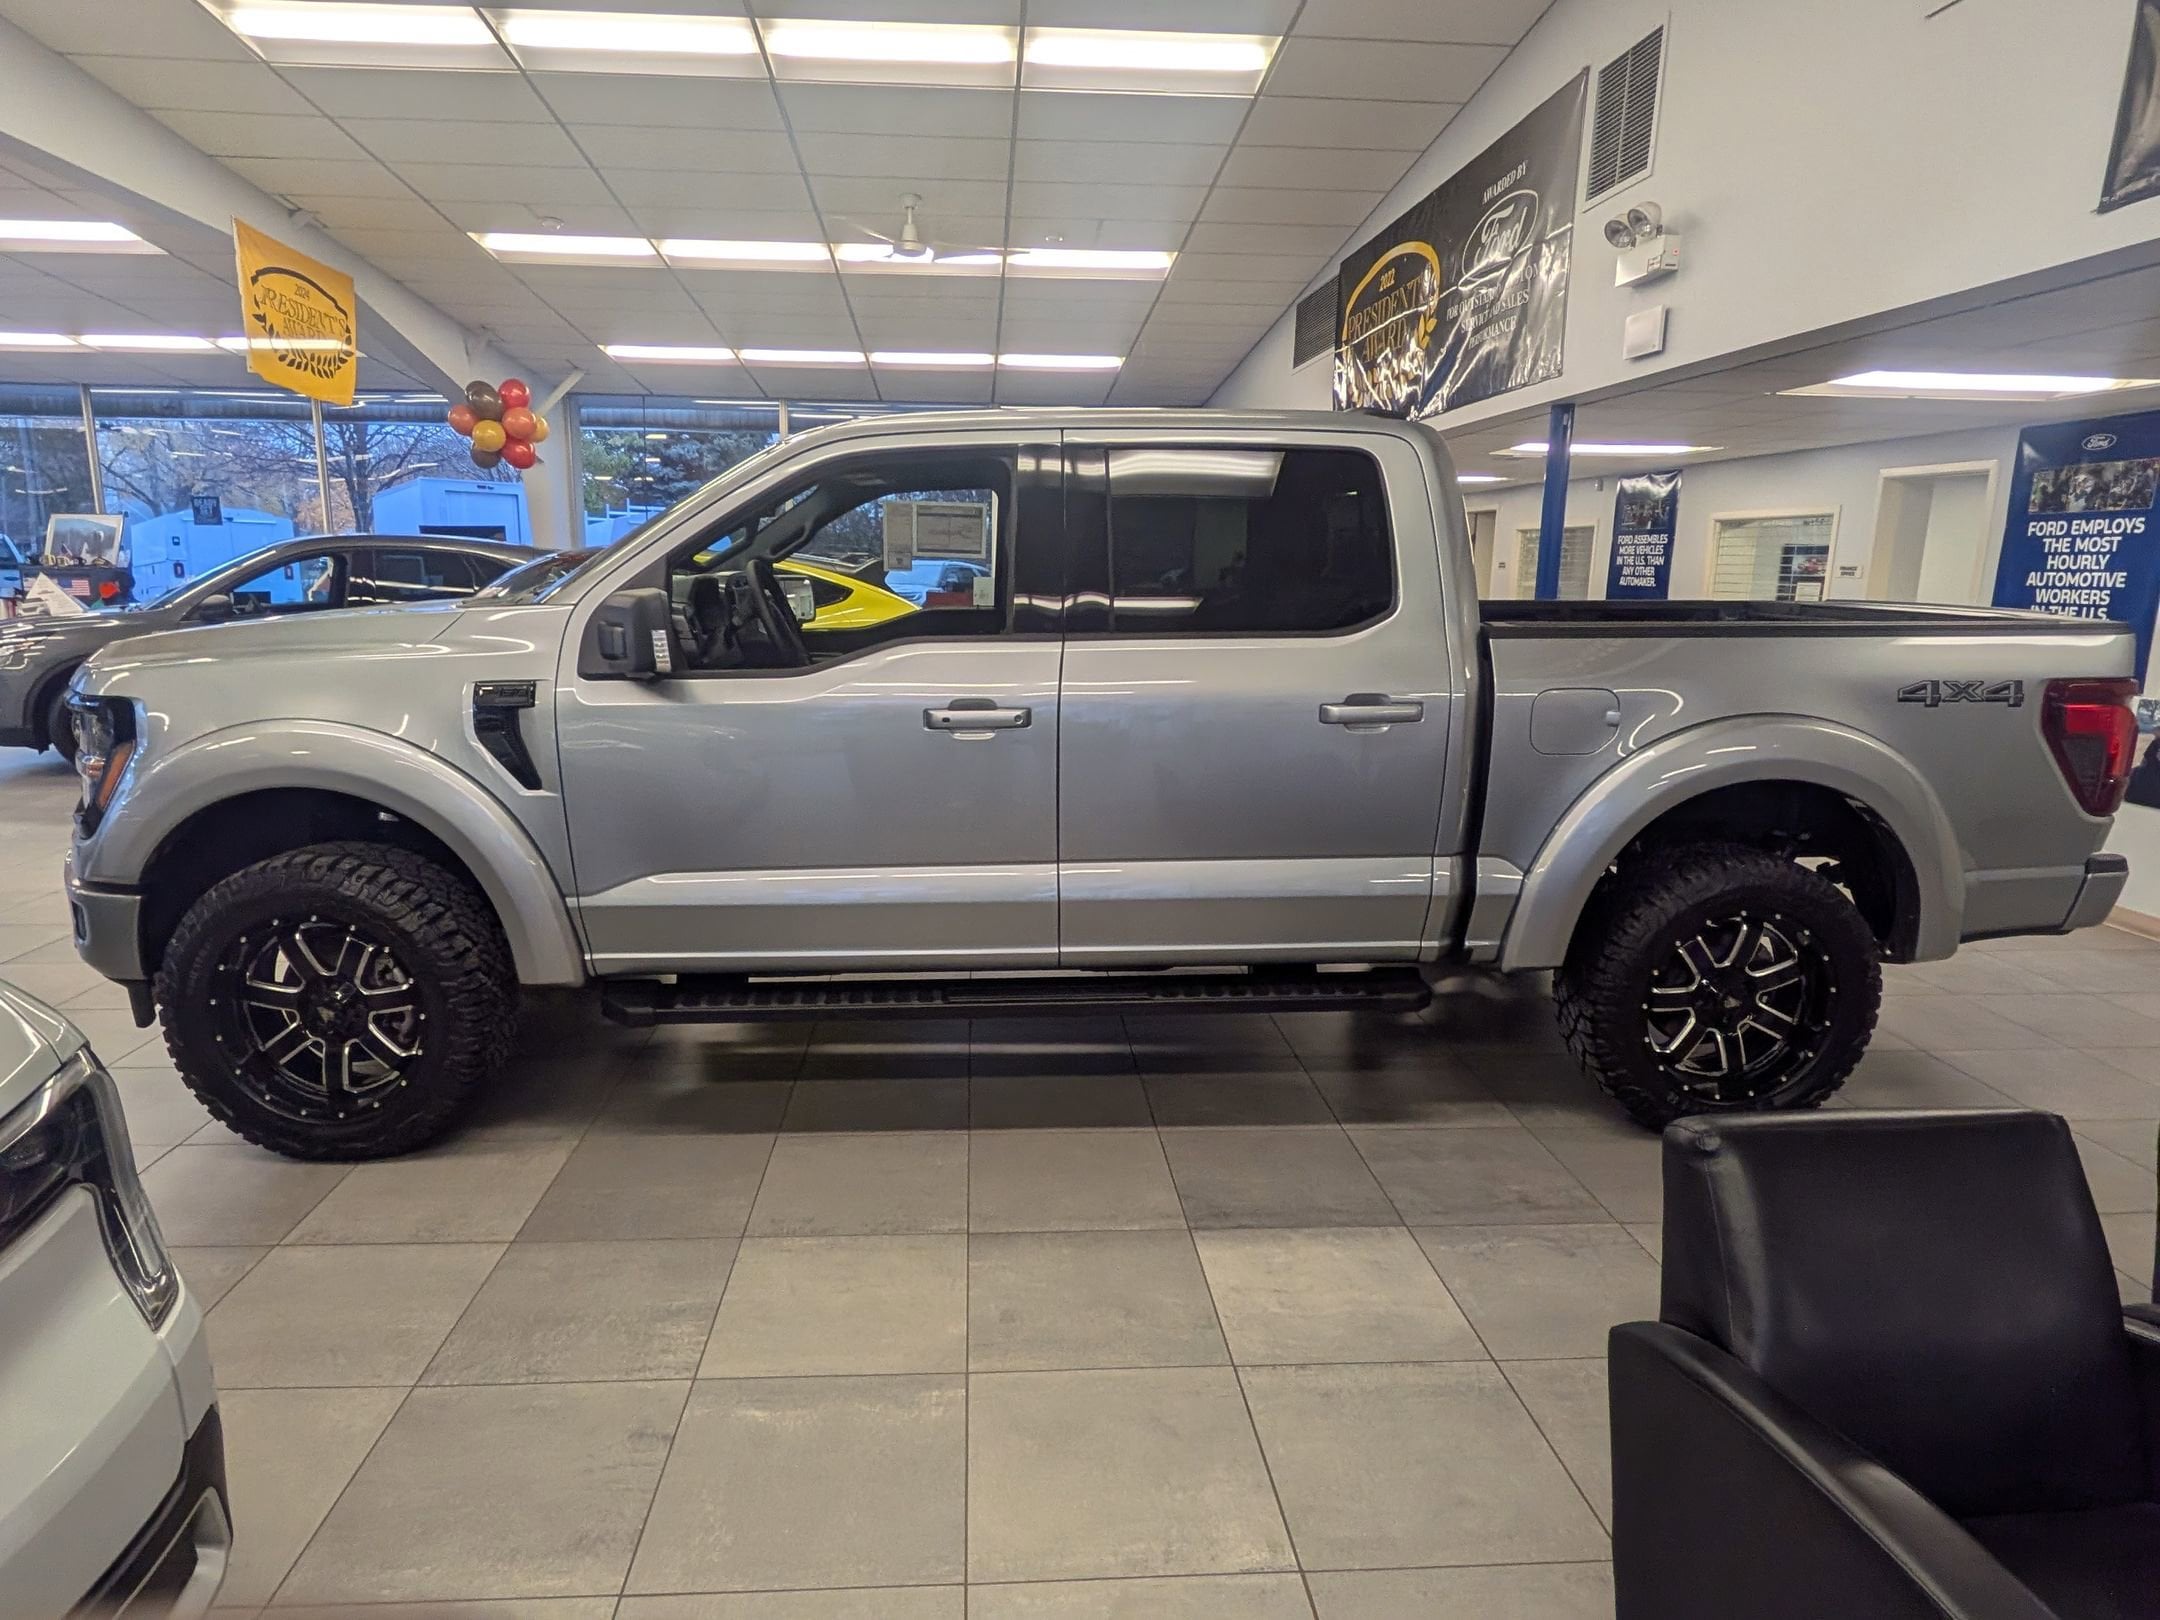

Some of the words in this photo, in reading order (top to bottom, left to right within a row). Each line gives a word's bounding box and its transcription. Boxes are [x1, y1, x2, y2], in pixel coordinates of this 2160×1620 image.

[1482, 170, 1517, 204] AWARDED
[1517, 160, 1528, 180] BY
[1474, 203, 1528, 266] Ford
[1379, 268, 1395, 292] 2022
[1501, 288, 1530, 312] SALES
[260, 285, 346, 338] PRESIDENT'S
[1447, 304, 1459, 321] FOR
[2028, 521, 2068, 537] FORD
[2070, 517, 2146, 536] EMPLOYS
[1617, 535, 1633, 545] FORD
[1633, 533, 1669, 545] ASSEMBLES
[2042, 537, 2072, 553] THE
[2074, 536, 2122, 553] MOST
[1618, 545, 1635, 555] MORE
[1635, 544, 1664, 555] VEHICLES
[1616, 555, 1623, 566] IN
[1623, 555, 1635, 566] THE
[1646, 555, 1665, 566] THAN
[2046, 554, 2111, 570] HOURLY
[1622, 566, 1634, 576] ANY
[1634, 566, 1655, 576] OTHER
[2025, 571, 2128, 588] AUTOMOTIVE
[1618, 576, 1656, 587] AUTOMAKER.
[2035, 588, 2111, 606] WORKERS
